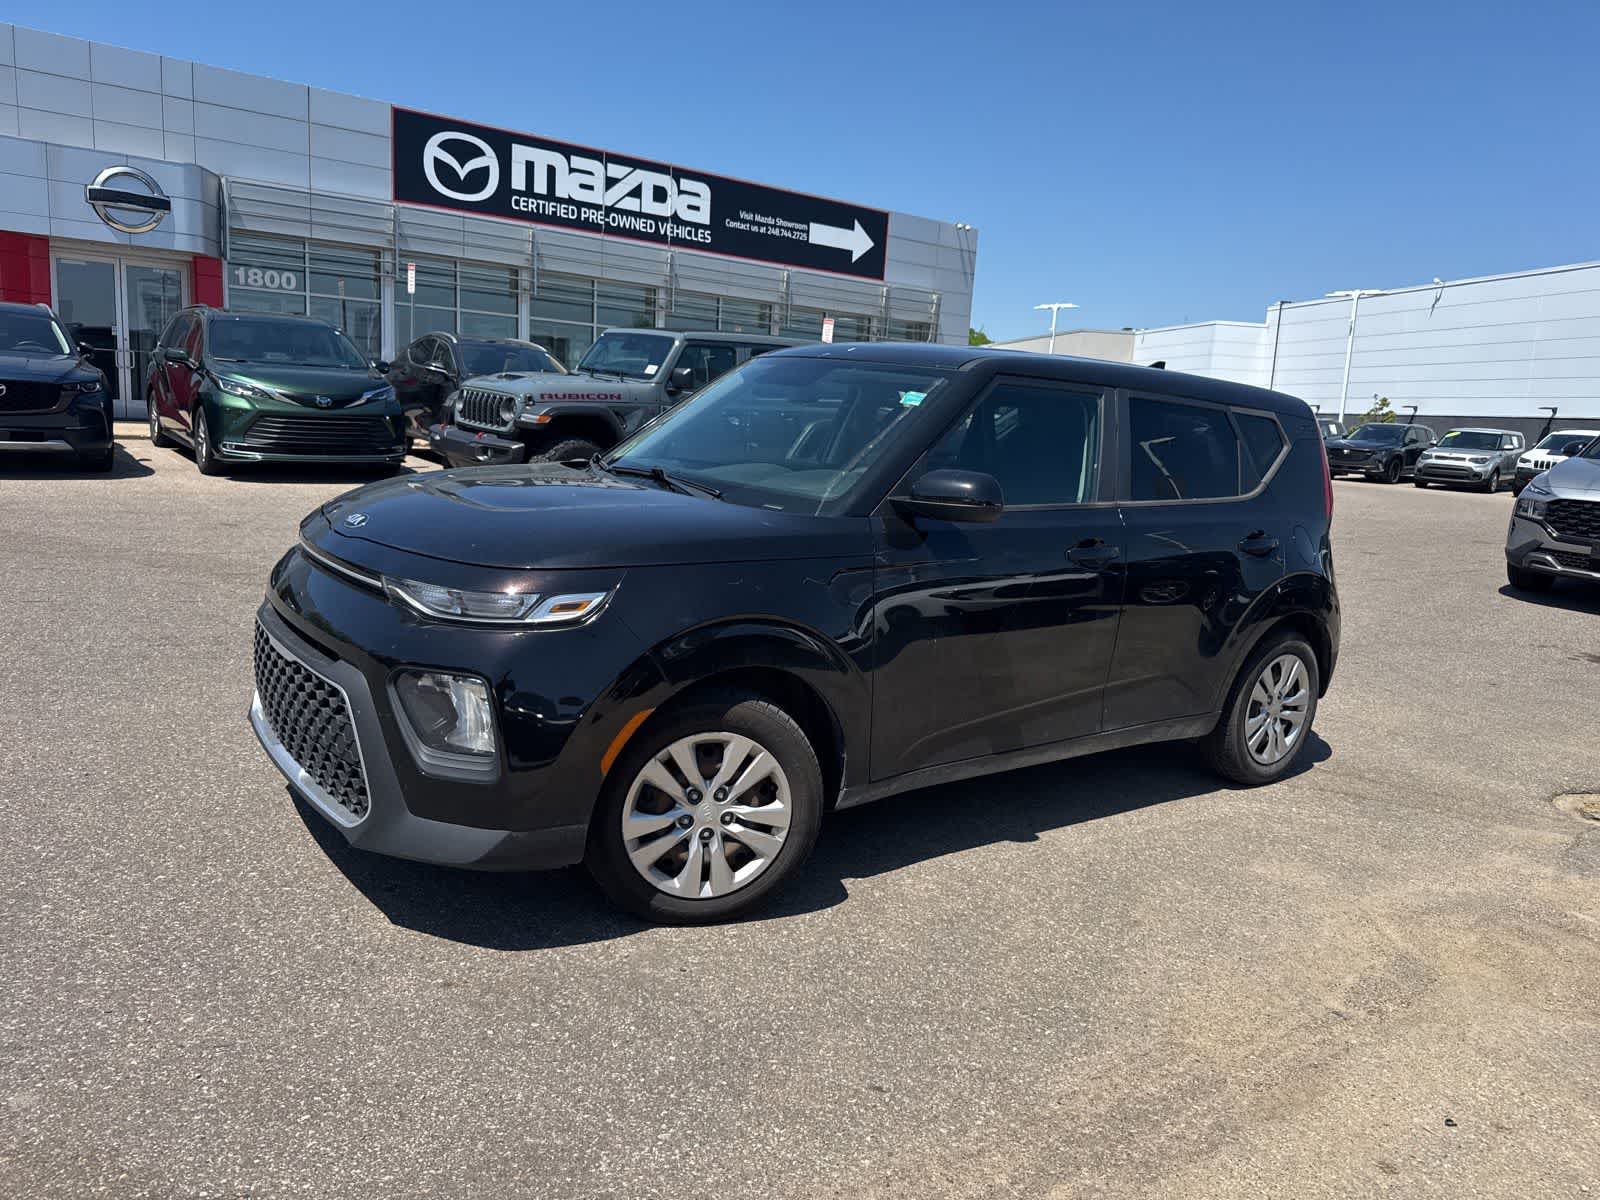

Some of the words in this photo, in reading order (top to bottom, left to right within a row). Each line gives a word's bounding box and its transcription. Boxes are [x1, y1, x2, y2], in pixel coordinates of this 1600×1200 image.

[511, 195, 578, 220] CERTIFIED
[580, 207, 656, 233] PRE-OWNED
[658, 222, 712, 243] VEHICLES
[725, 218, 750, 231] Contact
[750, 225, 759, 233] us
[759, 226, 767, 234] at
[739, 209, 754, 221] Visit
[754, 213, 775, 225] Mazda
[775, 217, 808, 231] Showroom
[234, 266, 297, 290] 1800
[539, 392, 623, 401] RUBICON
